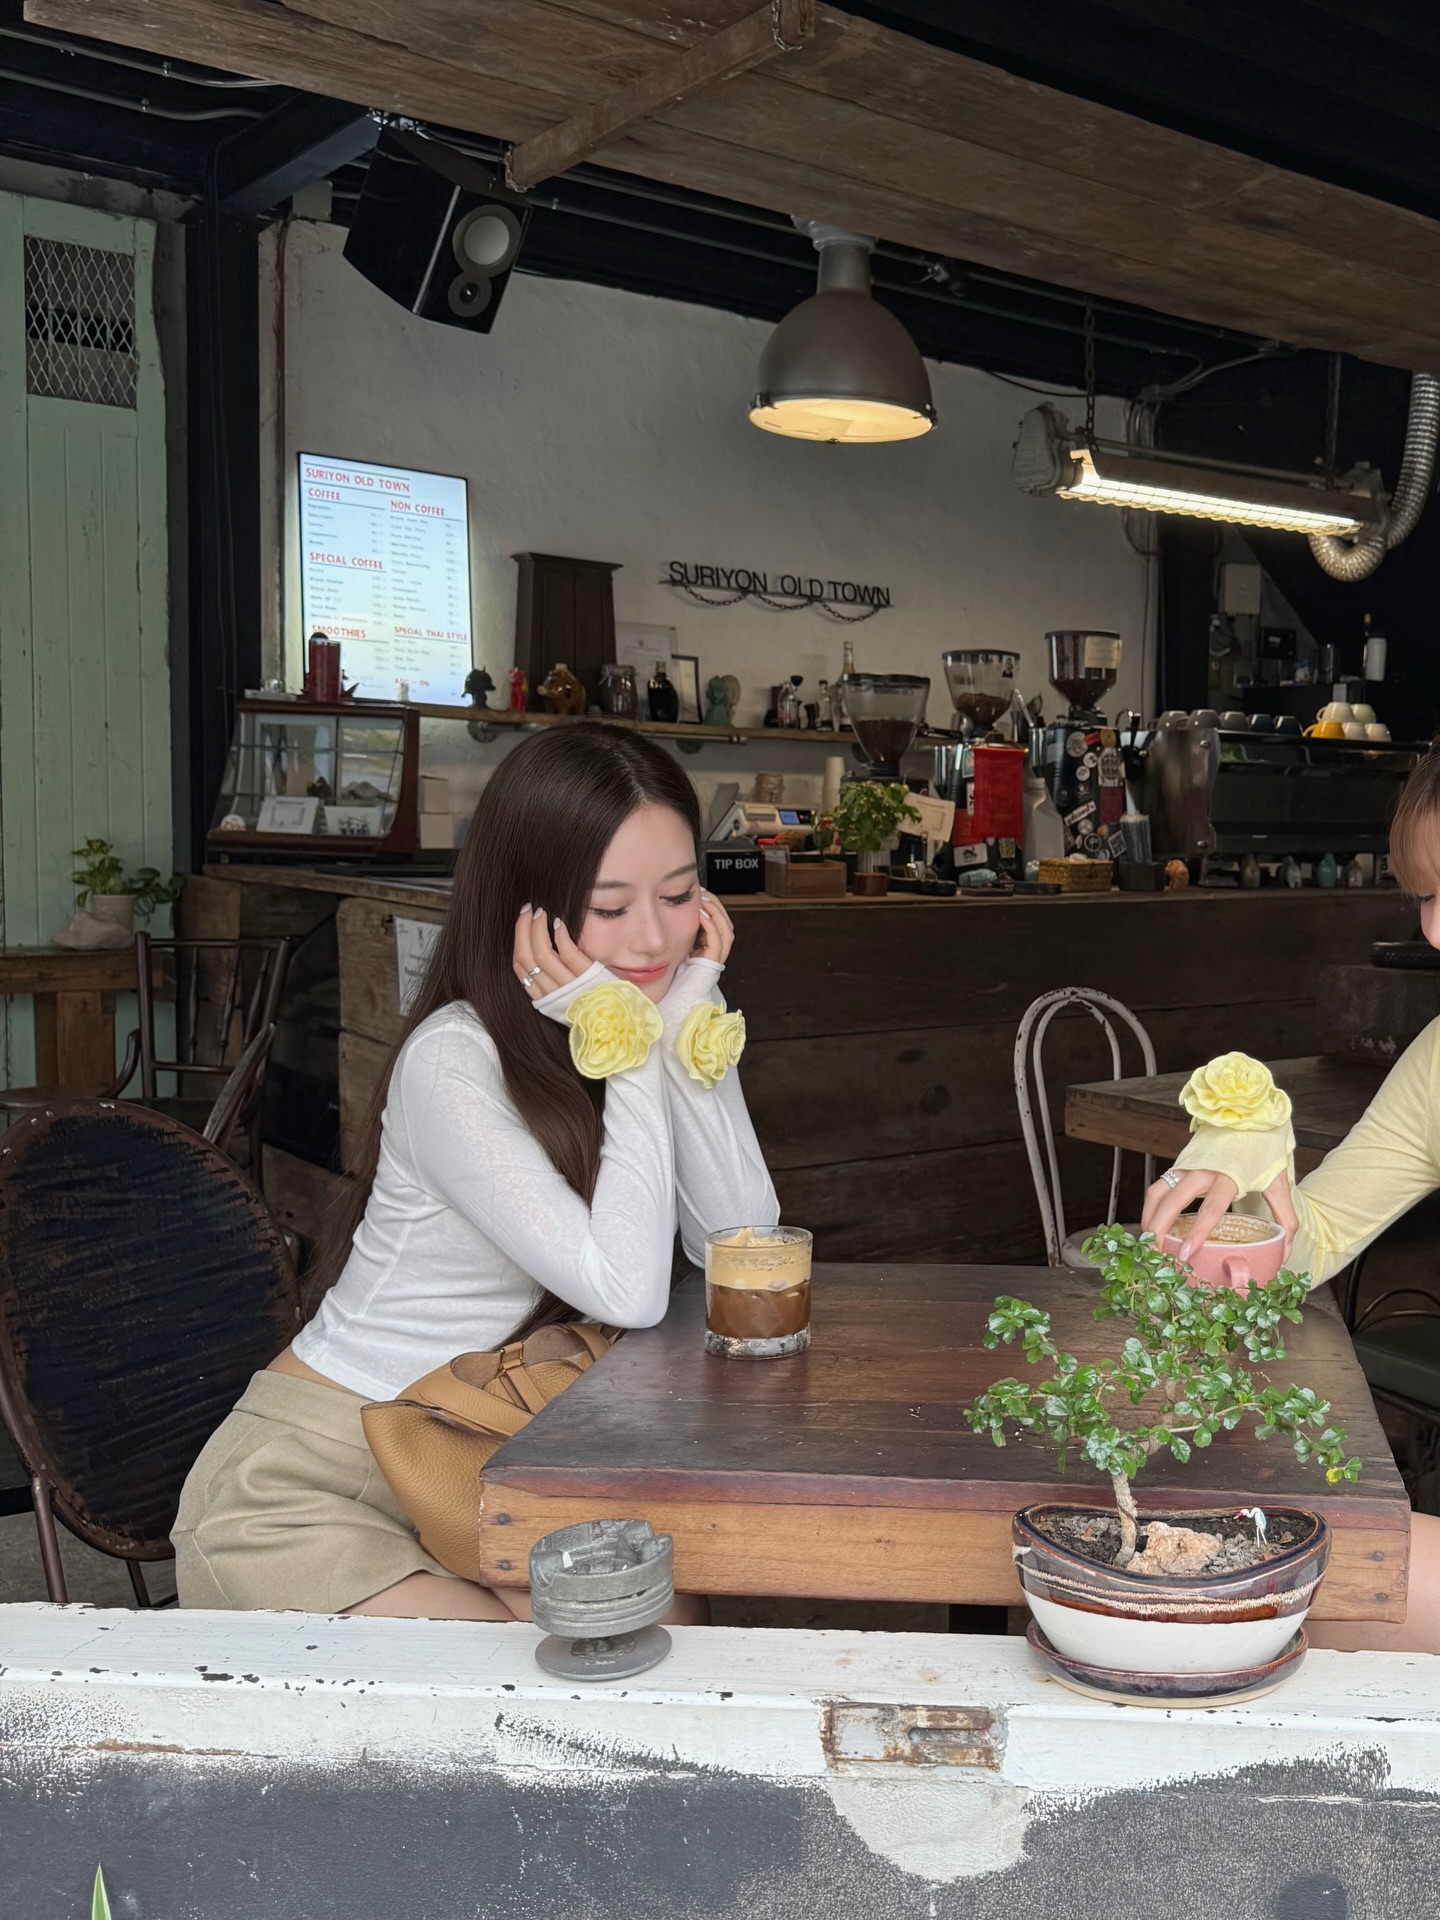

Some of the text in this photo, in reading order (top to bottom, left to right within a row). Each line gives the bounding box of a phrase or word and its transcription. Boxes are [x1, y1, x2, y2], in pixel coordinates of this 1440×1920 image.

[306, 467, 410, 492] SURIYON OLD TOWN
[308, 487, 341, 500] COFFEE
[390, 500, 446, 516] NON COFFEE
[309, 552, 384, 570] SPECIAL COFFEE
[668, 561, 891, 606] SURIYON OLD TOWN
[311, 624, 367, 639] SMOOTHIES
[394, 626, 468, 640] SPECIAL THAI STYLE
[714, 858, 759, 870] TIP BOX
